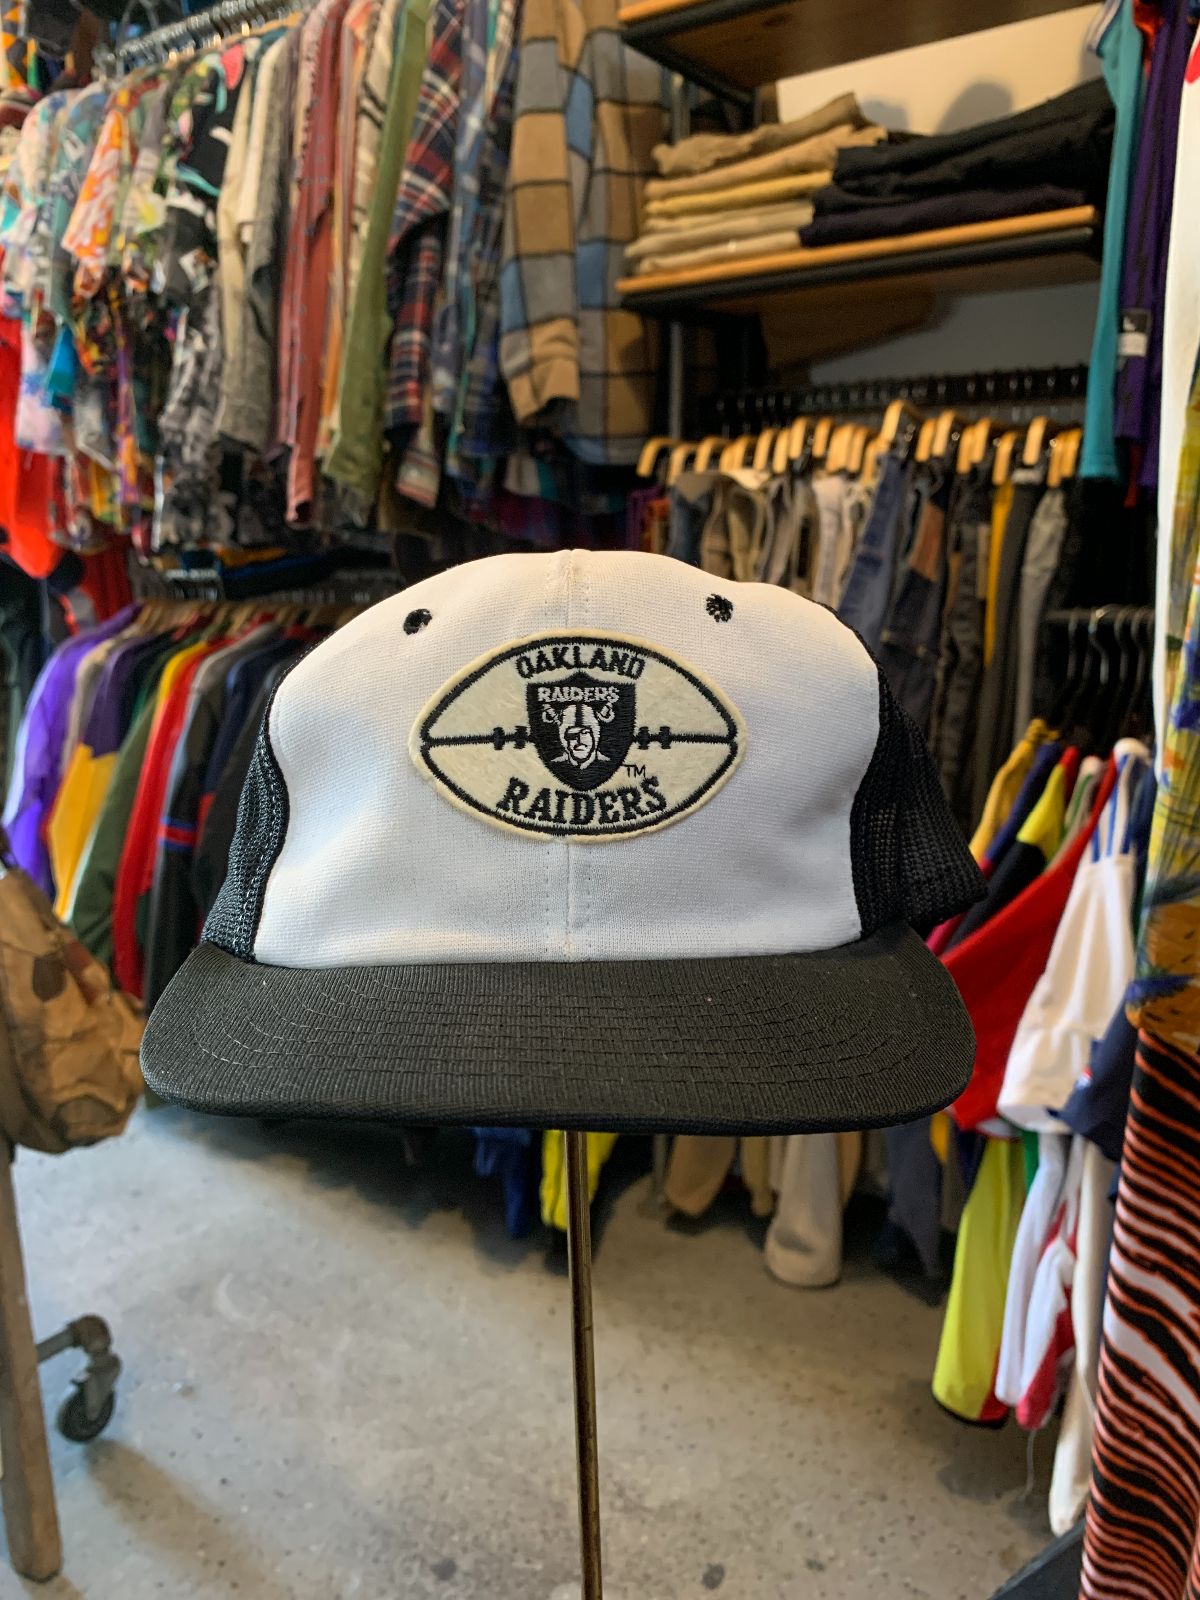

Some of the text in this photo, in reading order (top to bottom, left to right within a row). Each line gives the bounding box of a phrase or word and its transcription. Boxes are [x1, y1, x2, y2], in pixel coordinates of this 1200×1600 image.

[516, 646, 645, 679] OAKLAND
[537, 686, 619, 703] RAIDERS
[625, 764, 646, 778] TM
[496, 776, 667, 825] RAIDERS
